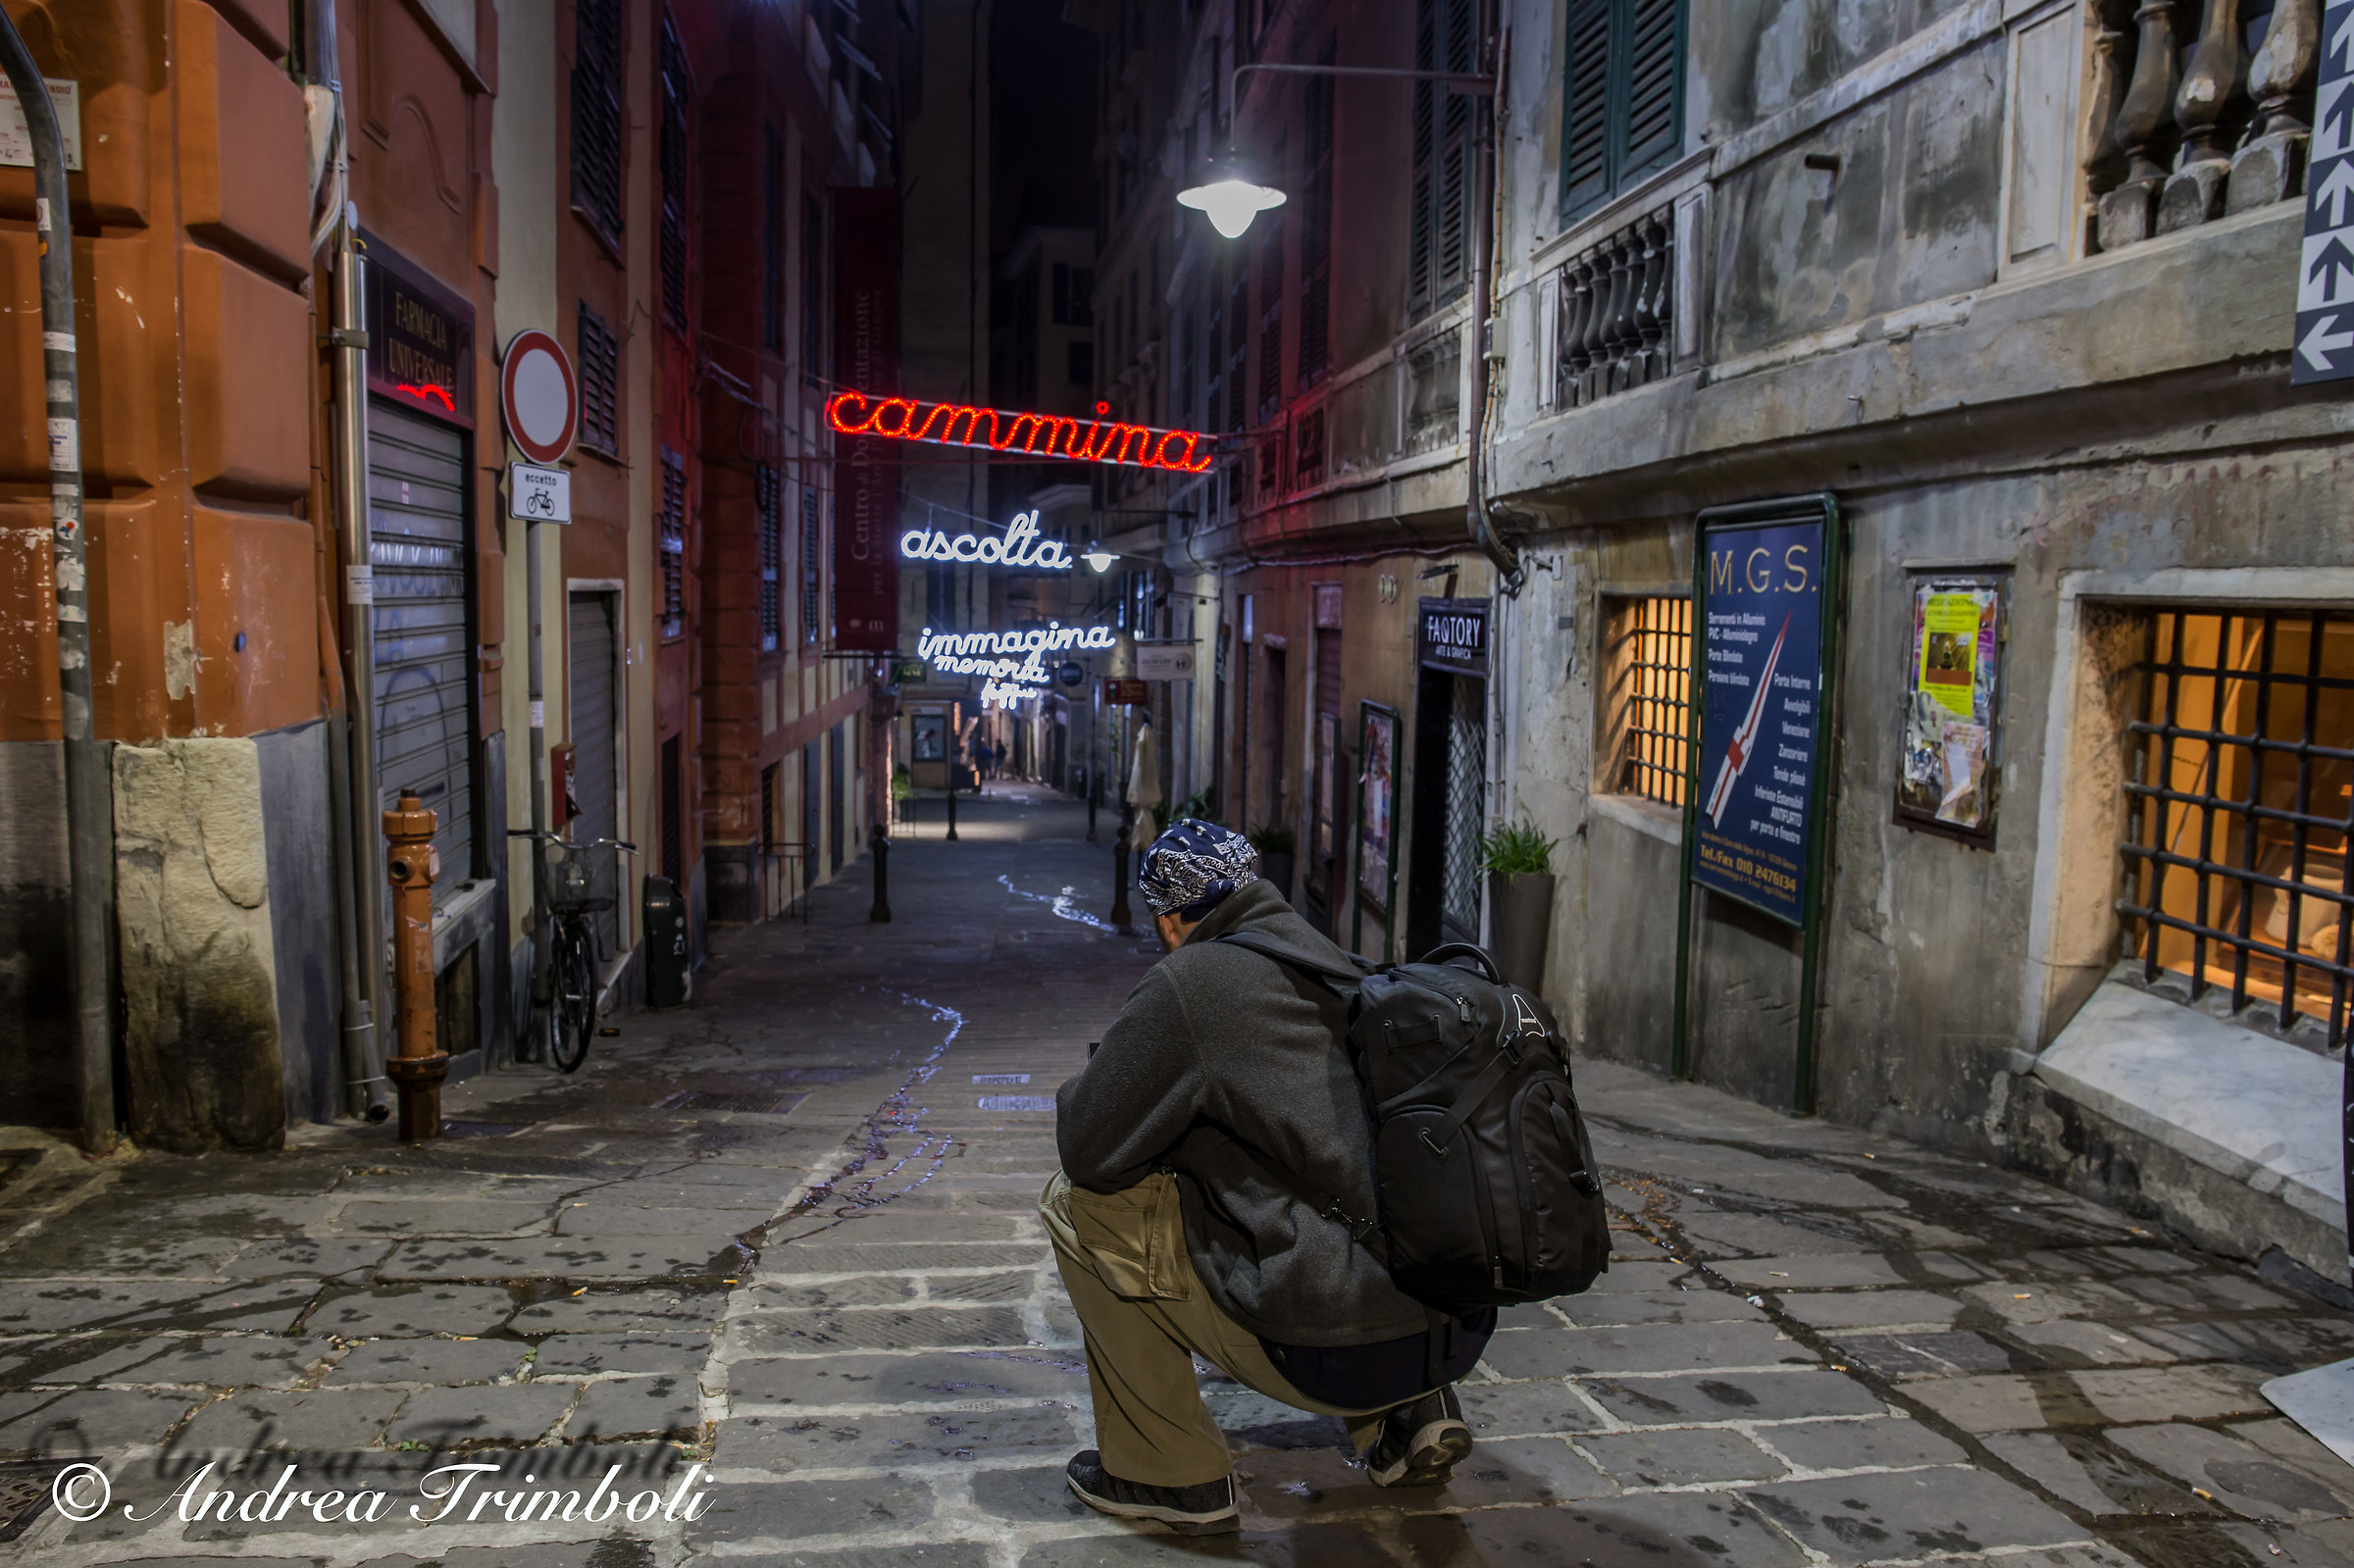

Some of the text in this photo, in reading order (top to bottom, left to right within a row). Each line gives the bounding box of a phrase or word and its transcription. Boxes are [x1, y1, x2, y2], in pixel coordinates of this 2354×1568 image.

[395, 291, 448, 352] FARMACIA
[388, 336, 453, 398] UNIVERSALE
[830, 391, 1212, 473] cammina
[525, 474, 557, 486] eccetto
[850, 488, 870, 561] Centro
[899, 509, 1073, 569] ascolta
[1709, 544, 1817, 595] M.G.S.
[918, 621, 1116, 667] immagina
[934, 654, 1050, 683] memoria
[1435, 644, 1446, 657] ARTE
[1769, 805, 1803, 828] ANTIFURTO
[1700, 843, 1734, 869] Tel./Fax
[1736, 857, 1754, 876] 010
[1755, 864, 1797, 893] 2476134
